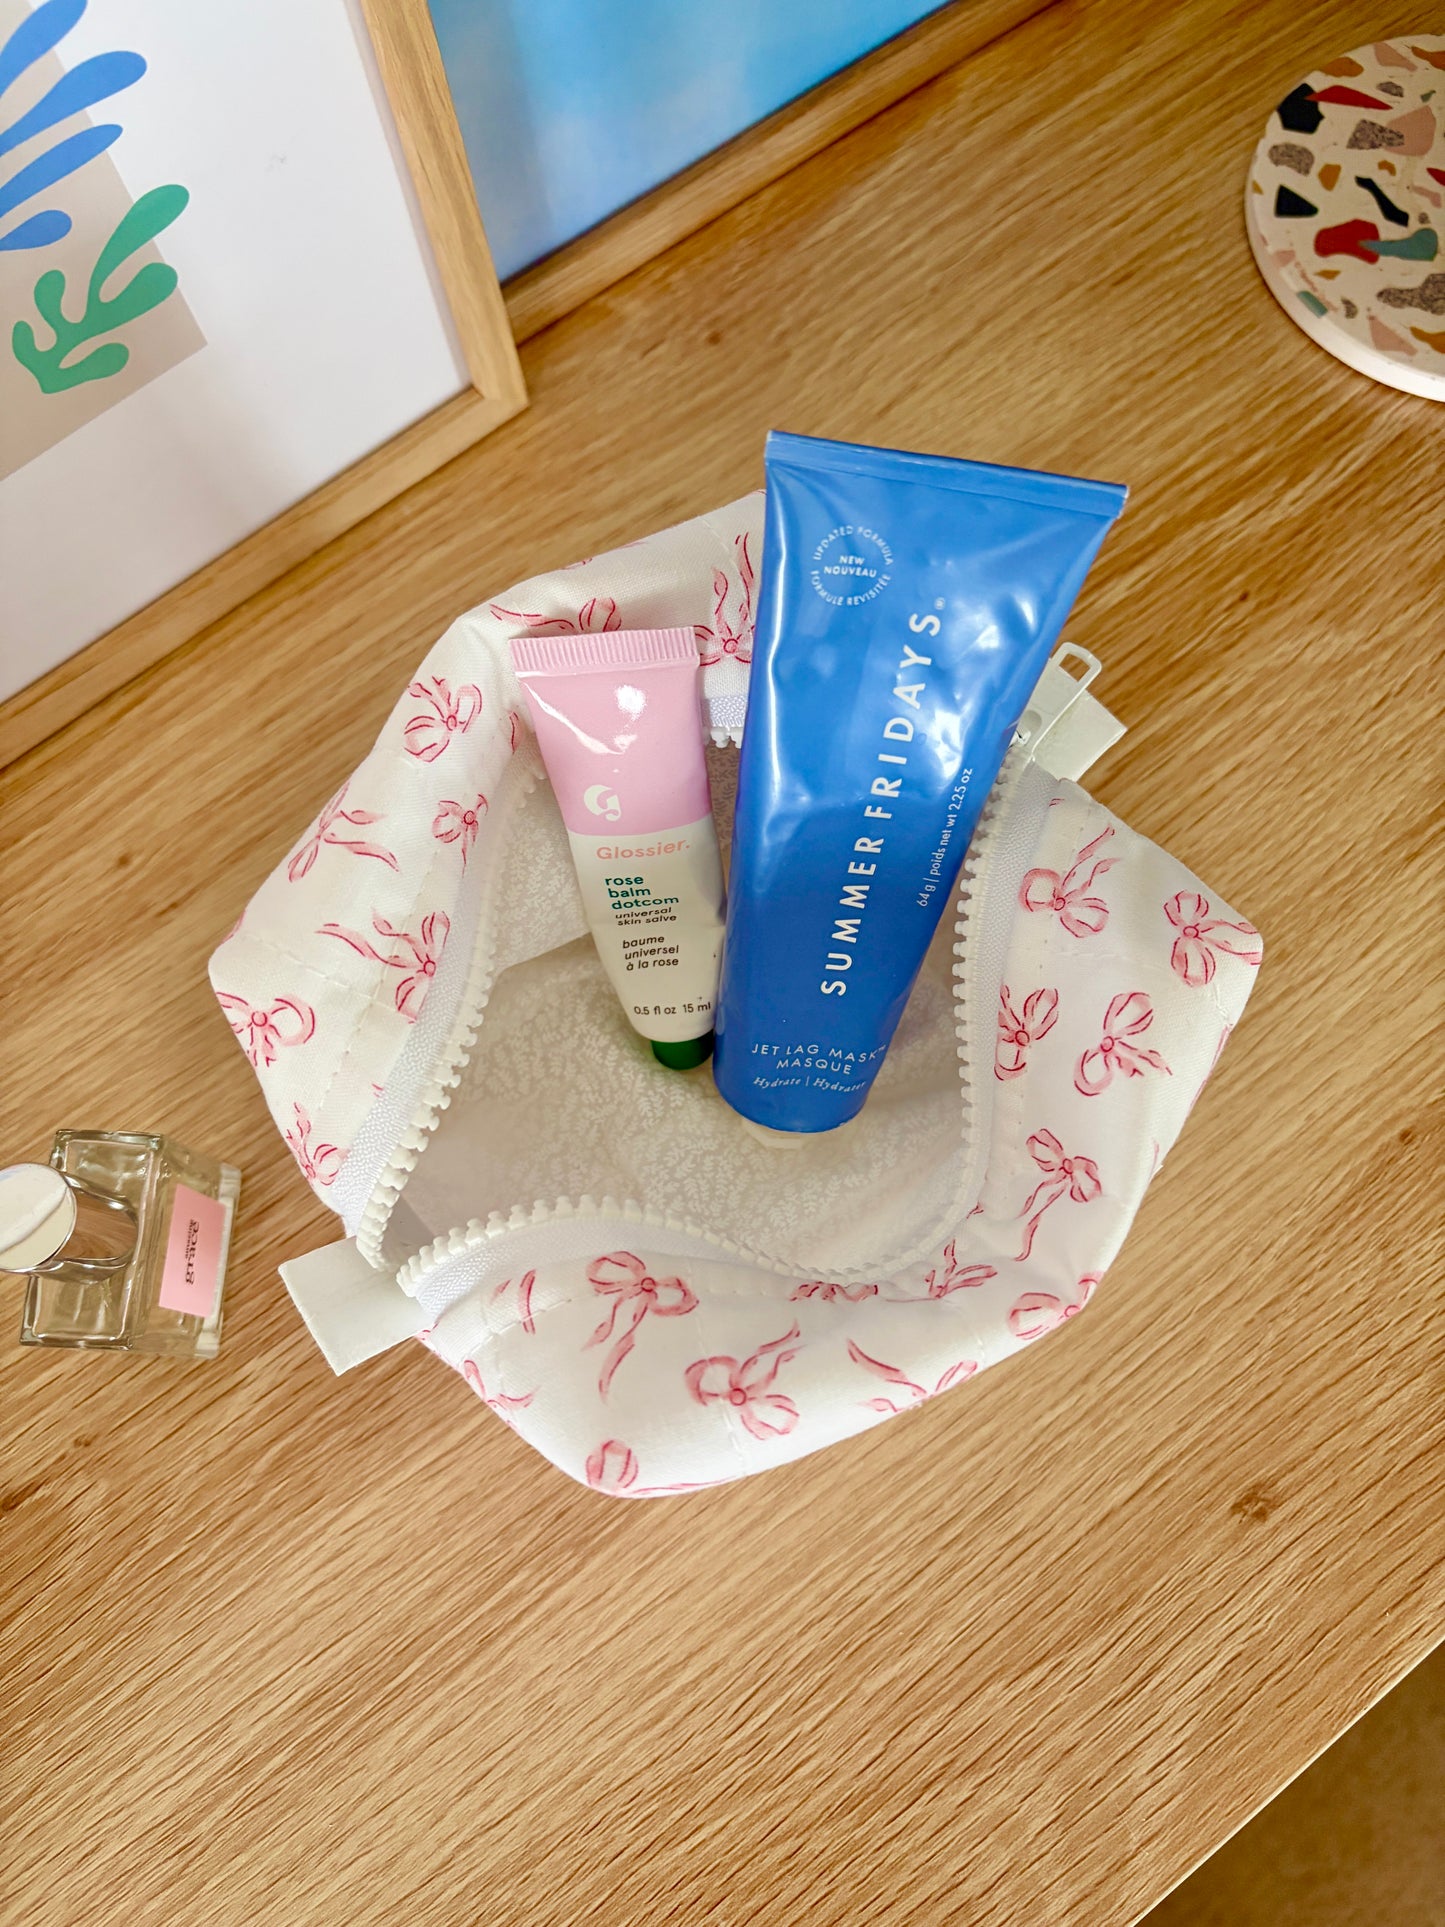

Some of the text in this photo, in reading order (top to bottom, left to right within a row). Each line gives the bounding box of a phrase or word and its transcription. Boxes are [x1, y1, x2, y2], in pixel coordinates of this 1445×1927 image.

[812, 525, 853, 561] UPDATED
[857, 526, 894, 566] FORMULA
[839, 555, 865, 565] NEW
[823, 566, 877, 578] NOUVEAU
[810, 570, 842, 606] FORMULE
[820, 612, 941, 997] SUMMER FRIDAYS
[916, 768, 973, 907] 64 g poids net wt 2.25 oz
[596, 839, 691, 860] Glossier.
[604, 875, 645, 886] rose
[607, 887, 651, 898] balm
[611, 896, 680, 910] dotcom
[615, 906, 673, 920] universal
[617, 914, 678, 926] skin salve
[622, 935, 666, 949] baume
[624, 944, 680, 960] universel
[626, 957, 680, 972] à la rose
[633, 1001, 713, 1016] 0.5 fl oz 15 ml
[751, 1043, 780, 1056] JET
[785, 1043, 820, 1056] LAG
[776, 1057, 852, 1075] MASQUE
[753, 1076, 801, 1090] Hydrate
[185, 1221, 199, 1285] grace
